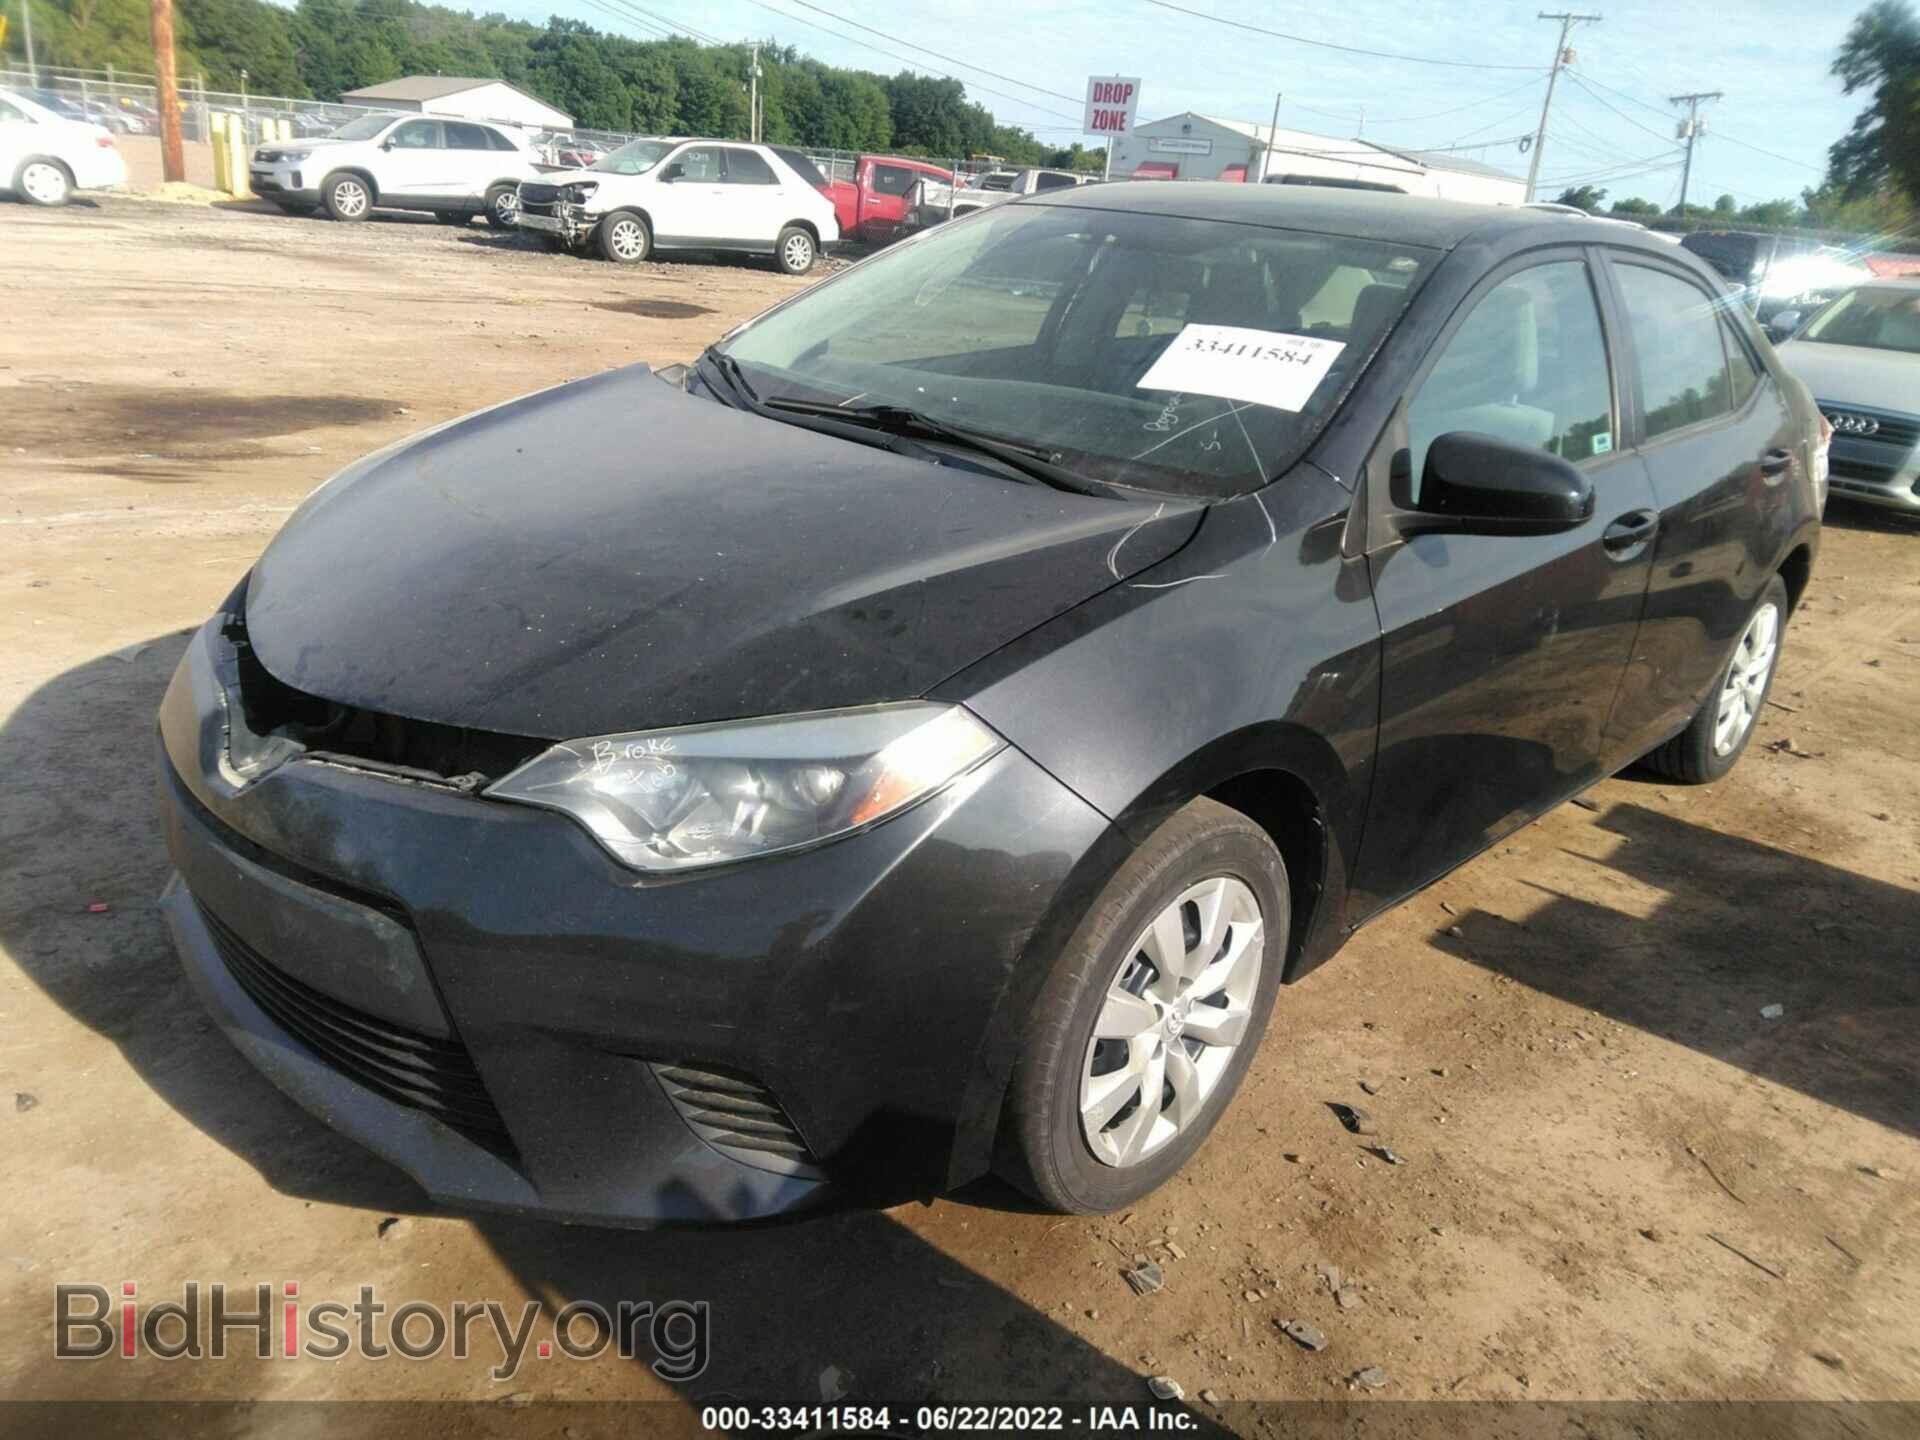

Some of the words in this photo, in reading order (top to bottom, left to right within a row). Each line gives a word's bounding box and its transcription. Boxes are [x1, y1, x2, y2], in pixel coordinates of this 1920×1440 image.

[1092, 82, 1134, 105] DROP
[1091, 109, 1127, 132] ZONE
[1186, 338, 1313, 365] 33411584
